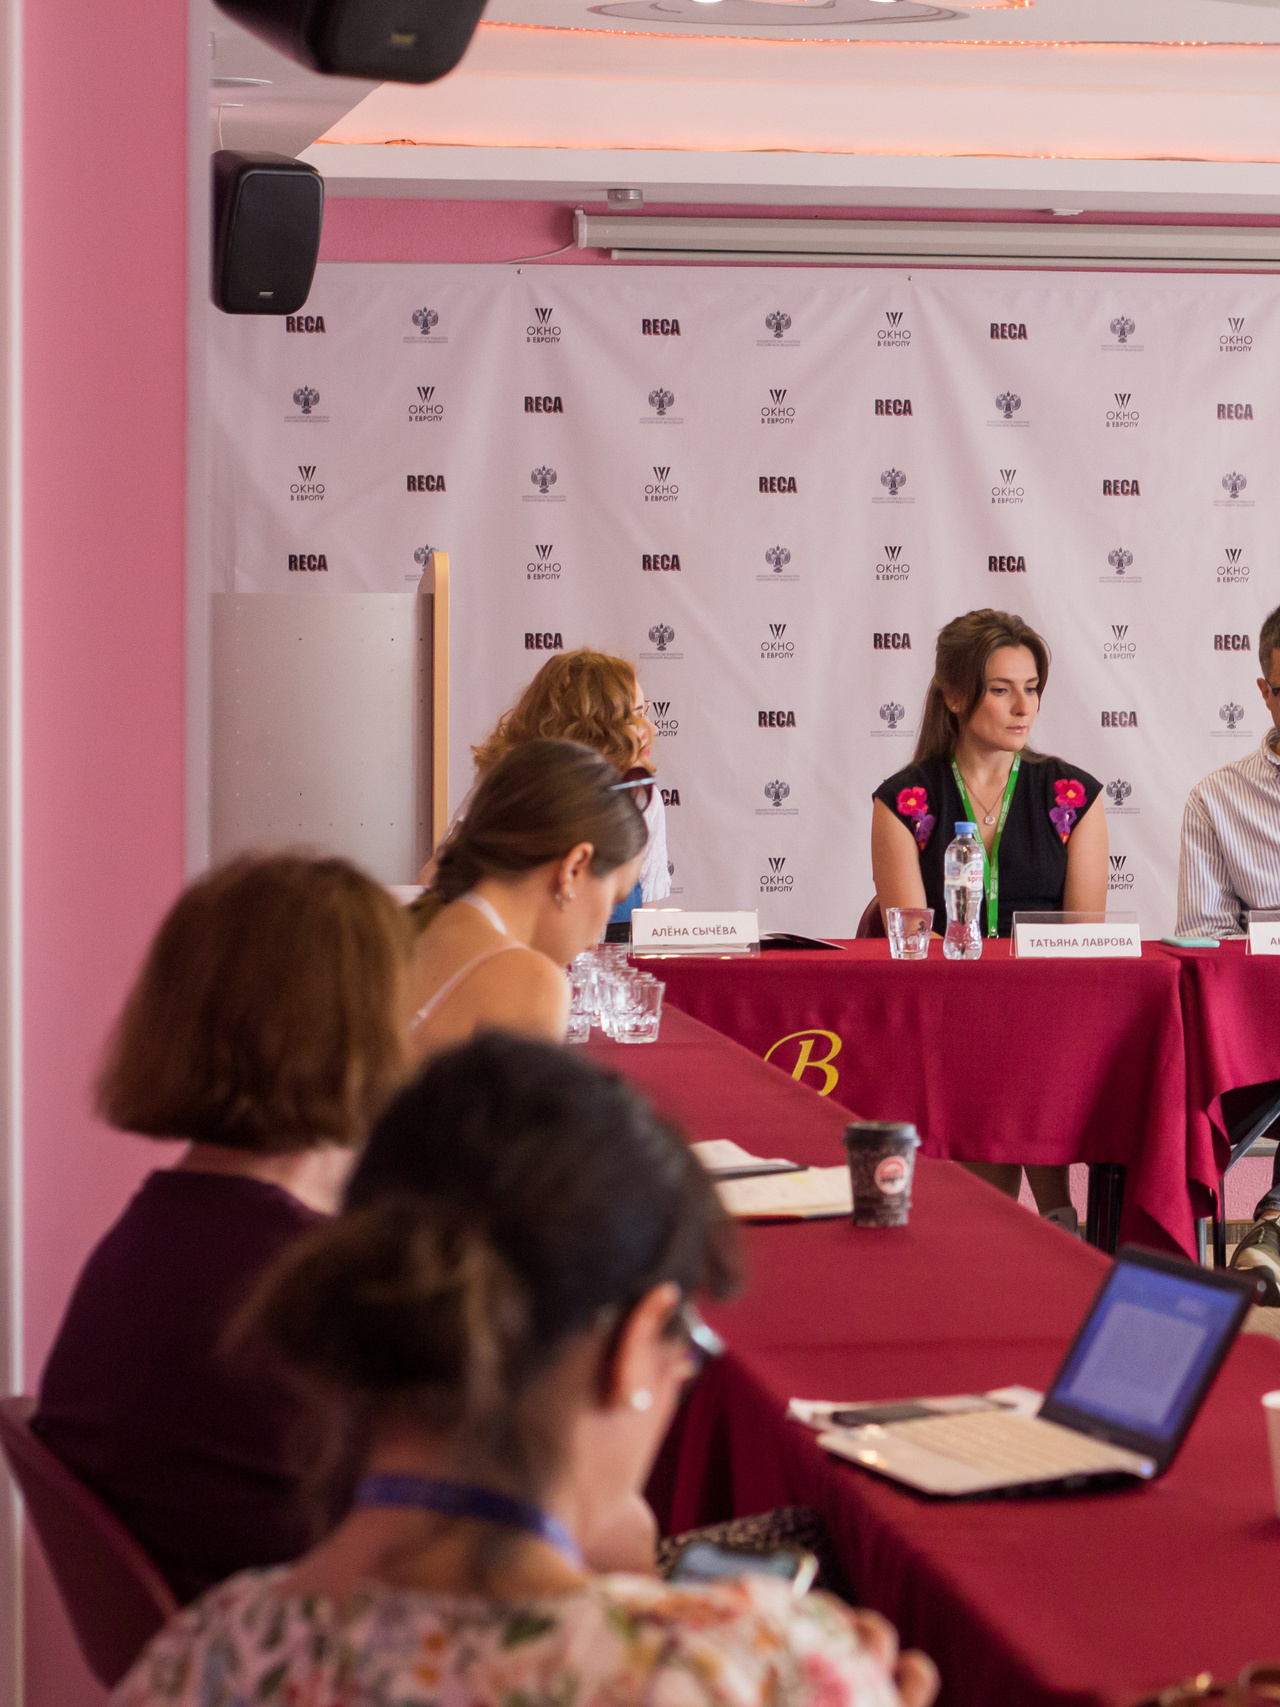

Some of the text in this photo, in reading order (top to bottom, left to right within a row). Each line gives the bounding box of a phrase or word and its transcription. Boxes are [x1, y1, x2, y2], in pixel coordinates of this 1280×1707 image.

[286, 316, 326, 333] RECA
[527, 326, 561, 335] ОКНО
[642, 319, 681, 336] RECA
[877, 330, 911, 339] ОКНО
[990, 323, 1028, 340] RECA
[1220, 336, 1252, 344] ОКНО
[409, 405, 443, 414] ОКНО
[525, 396, 564, 414] RECA
[875, 399, 913, 417] RECA
[761, 407, 795, 416] ОКНО
[1106, 411, 1139, 420] ОКНО
[1217, 404, 1254, 421] RECA
[290, 484, 325, 493] ОКНО
[407, 475, 446, 493] RECA
[645, 485, 679, 494] ОКНО
[759, 477, 798, 494] RECA
[1103, 480, 1141, 497] RECA
[992, 487, 1024, 496] ОКНО
[289, 555, 328, 572] RECA
[527, 563, 561, 572] ОКНО
[643, 555, 682, 572] RECA
[876, 564, 910, 573] ОКНО
[989, 556, 1026, 573] RECA
[1217, 566, 1250, 575] ОКНО
[525, 633, 564, 650] RECA
[761, 642, 794, 651] ОКНО
[874, 633, 912, 650] RECA
[1104, 643, 1136, 652] ОКНО
[1214, 635, 1251, 651] RECA
[654, 720, 679, 729] КНО
[758, 711, 796, 728] RECA
[1101, 711, 1138, 728] RECA
[660, 789, 681, 806] CA
[760, 876, 794, 884] ОКНО
[1108, 874, 1134, 882] КНО
[652, 925, 737, 937] АЛЁНА СЫЧЁВА
[1029, 938, 1133, 948] ТАТЬЯНА ЛАВРОВА
